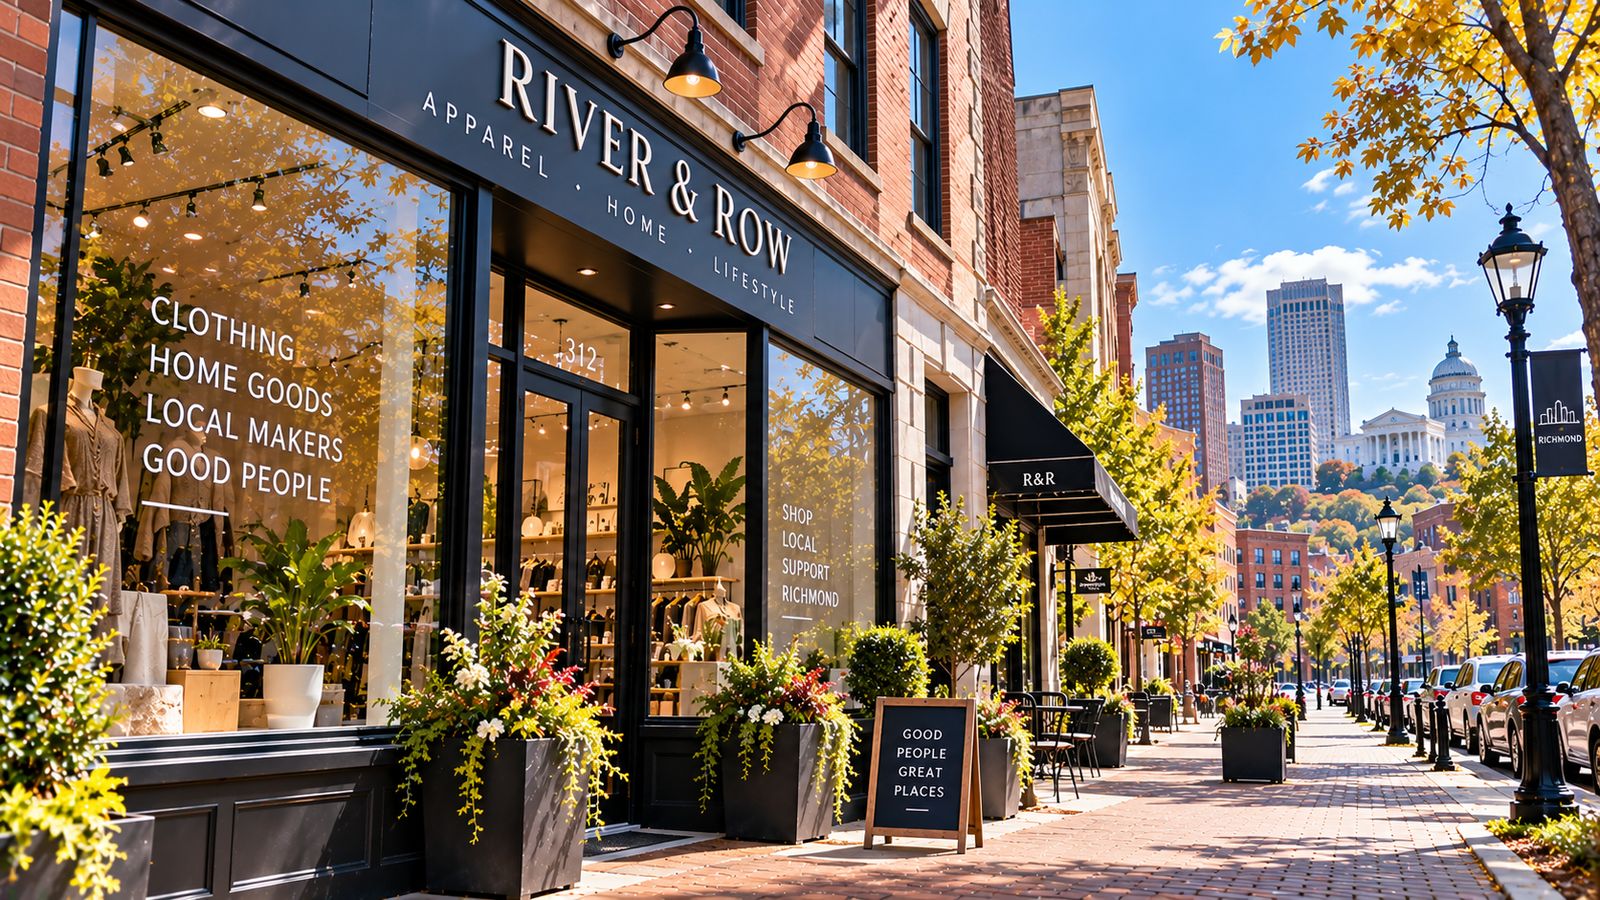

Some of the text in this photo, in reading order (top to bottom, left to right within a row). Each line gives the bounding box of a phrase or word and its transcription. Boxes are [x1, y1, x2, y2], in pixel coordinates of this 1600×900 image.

[500, 38, 792, 275] RIVER & ROW
[422, 91, 795, 315] APPAREL HOME LIFESTYLE
[151, 296, 294, 361] CLOTHING
[566, 338, 597, 372] 312
[149, 344, 332, 418] HOME GOODS
[145, 393, 343, 463] LOCAL MAKERS
[1538, 434, 1582, 444] RICHMOND
[142, 443, 331, 503] GOOD PEOPLE
[1022, 471, 1056, 487] R&R
[783, 504, 812, 525] SHOP
[783, 530, 817, 553] LOCAL
[783, 558, 830, 580] SUPPORT
[782, 585, 839, 607] RICHMOND
[902, 728, 943, 741] GOOD
[897, 747, 947, 760] PEOPLE
[898, 766, 943, 778] GREAT
[894, 785, 945, 798] PLACES
